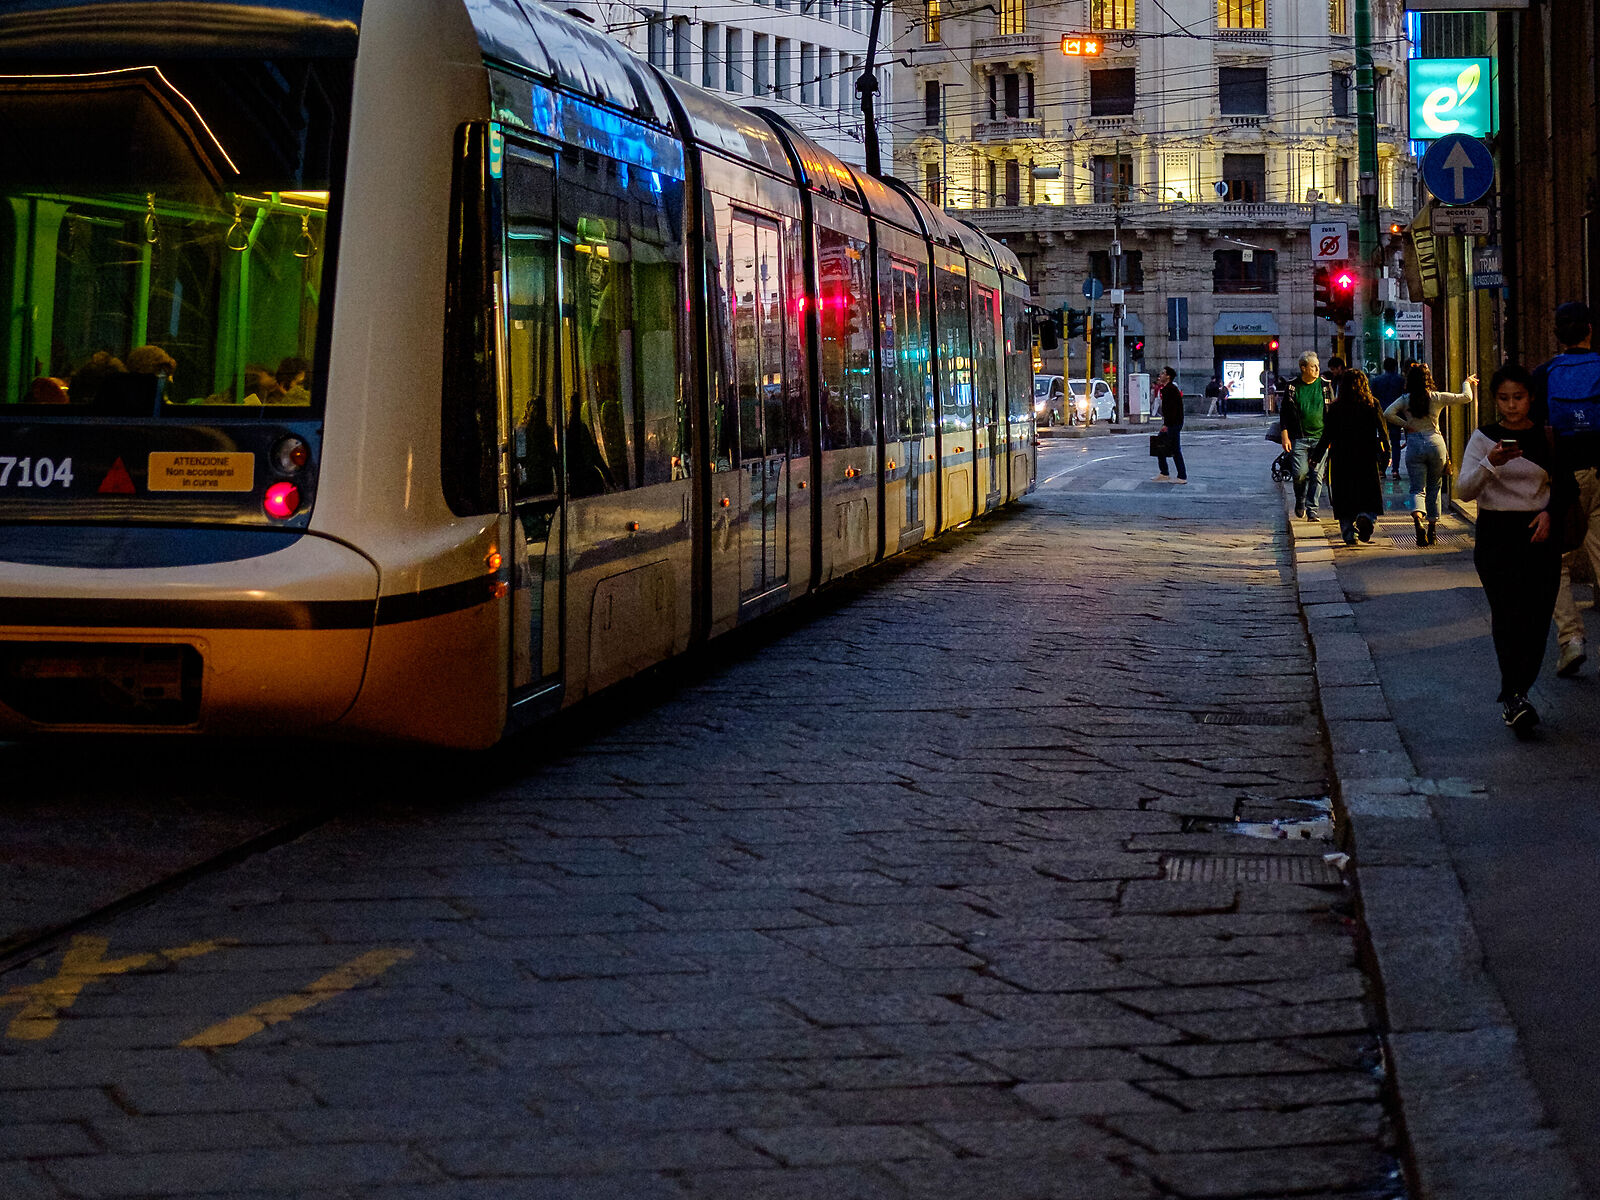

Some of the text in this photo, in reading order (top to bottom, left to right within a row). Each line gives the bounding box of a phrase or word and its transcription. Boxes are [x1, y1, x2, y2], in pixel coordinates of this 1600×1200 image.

[1479, 256, 1499, 273] TRAM
[173, 456, 230, 467] ATTENZIONE
[0, 456, 74, 488] 7104
[166, 467, 235, 477] Non accostarsi
[182, 478, 219, 487] in curva
